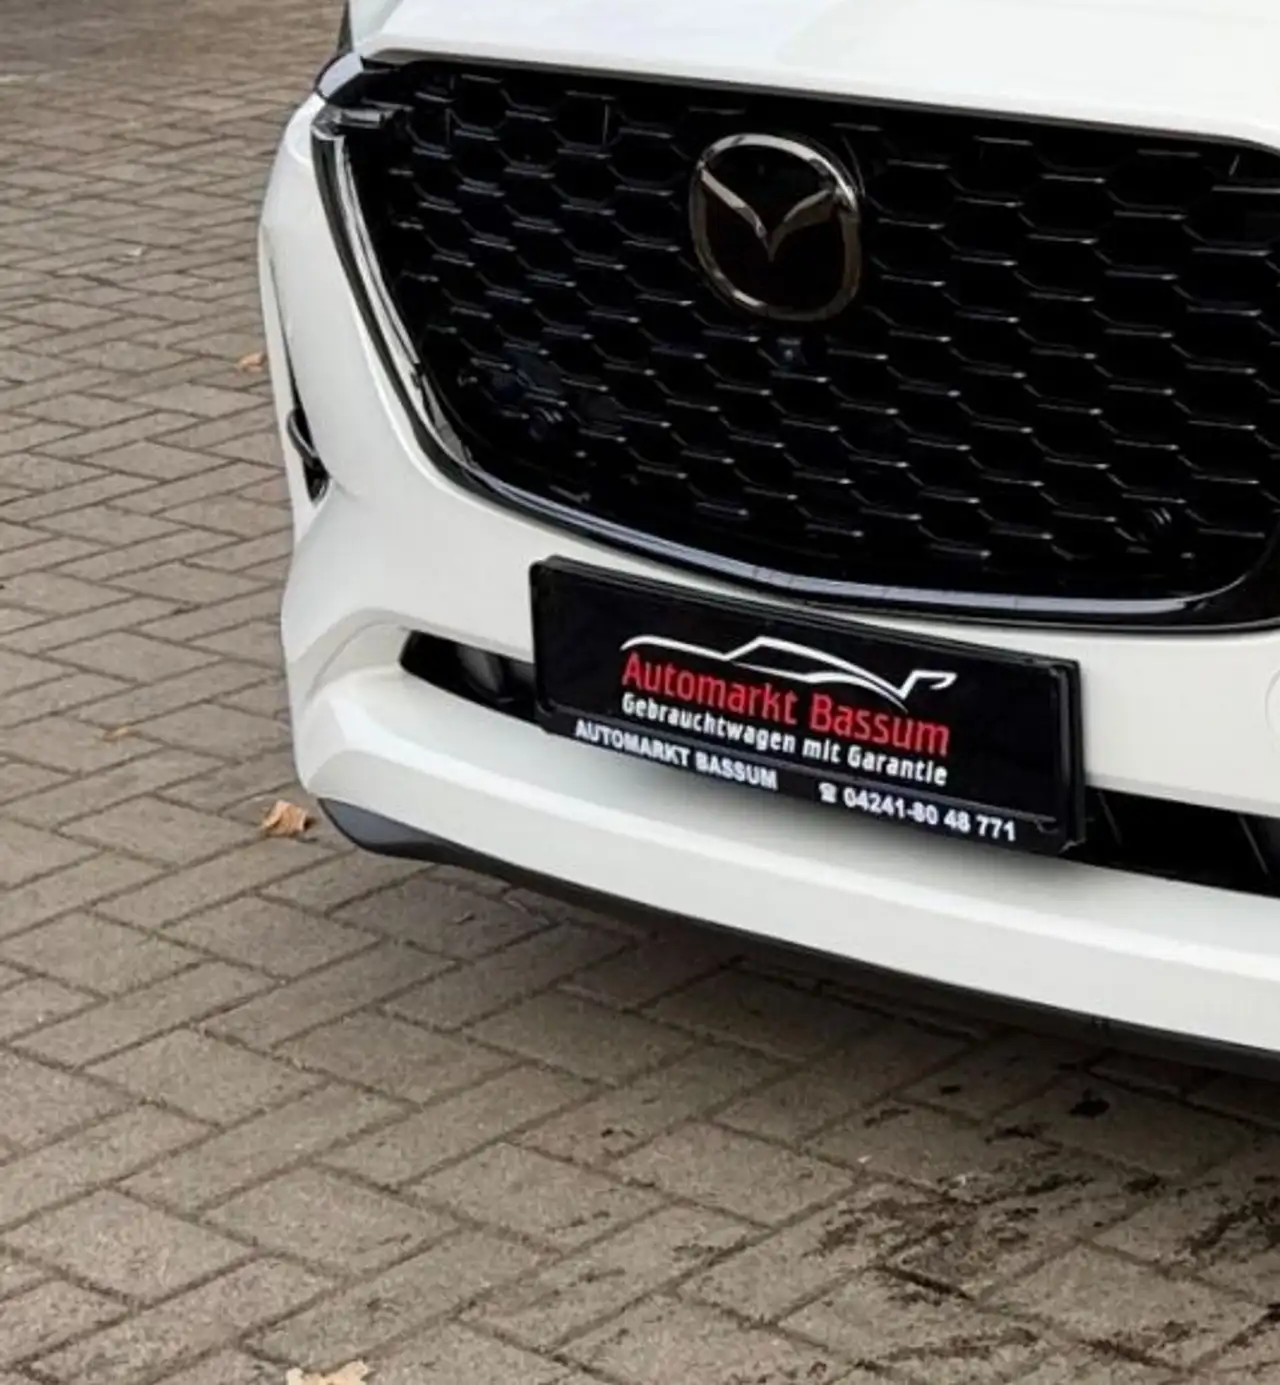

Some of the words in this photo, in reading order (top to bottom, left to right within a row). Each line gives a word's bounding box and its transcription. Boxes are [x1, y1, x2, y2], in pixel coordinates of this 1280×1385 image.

[621, 650, 799, 726] Automarkt
[809, 693, 950, 757] Bassum
[622, 692, 797, 753] Gebrauchtwagen
[802, 737, 841, 764] mit
[847, 744, 948, 787] Garantie
[575, 719, 691, 766] AUTOMARKT
[695, 751, 779, 791] BASSUM
[843, 787, 938, 826] 04241-80
[943, 809, 971, 834] 48
[977, 815, 1016, 842] 771
